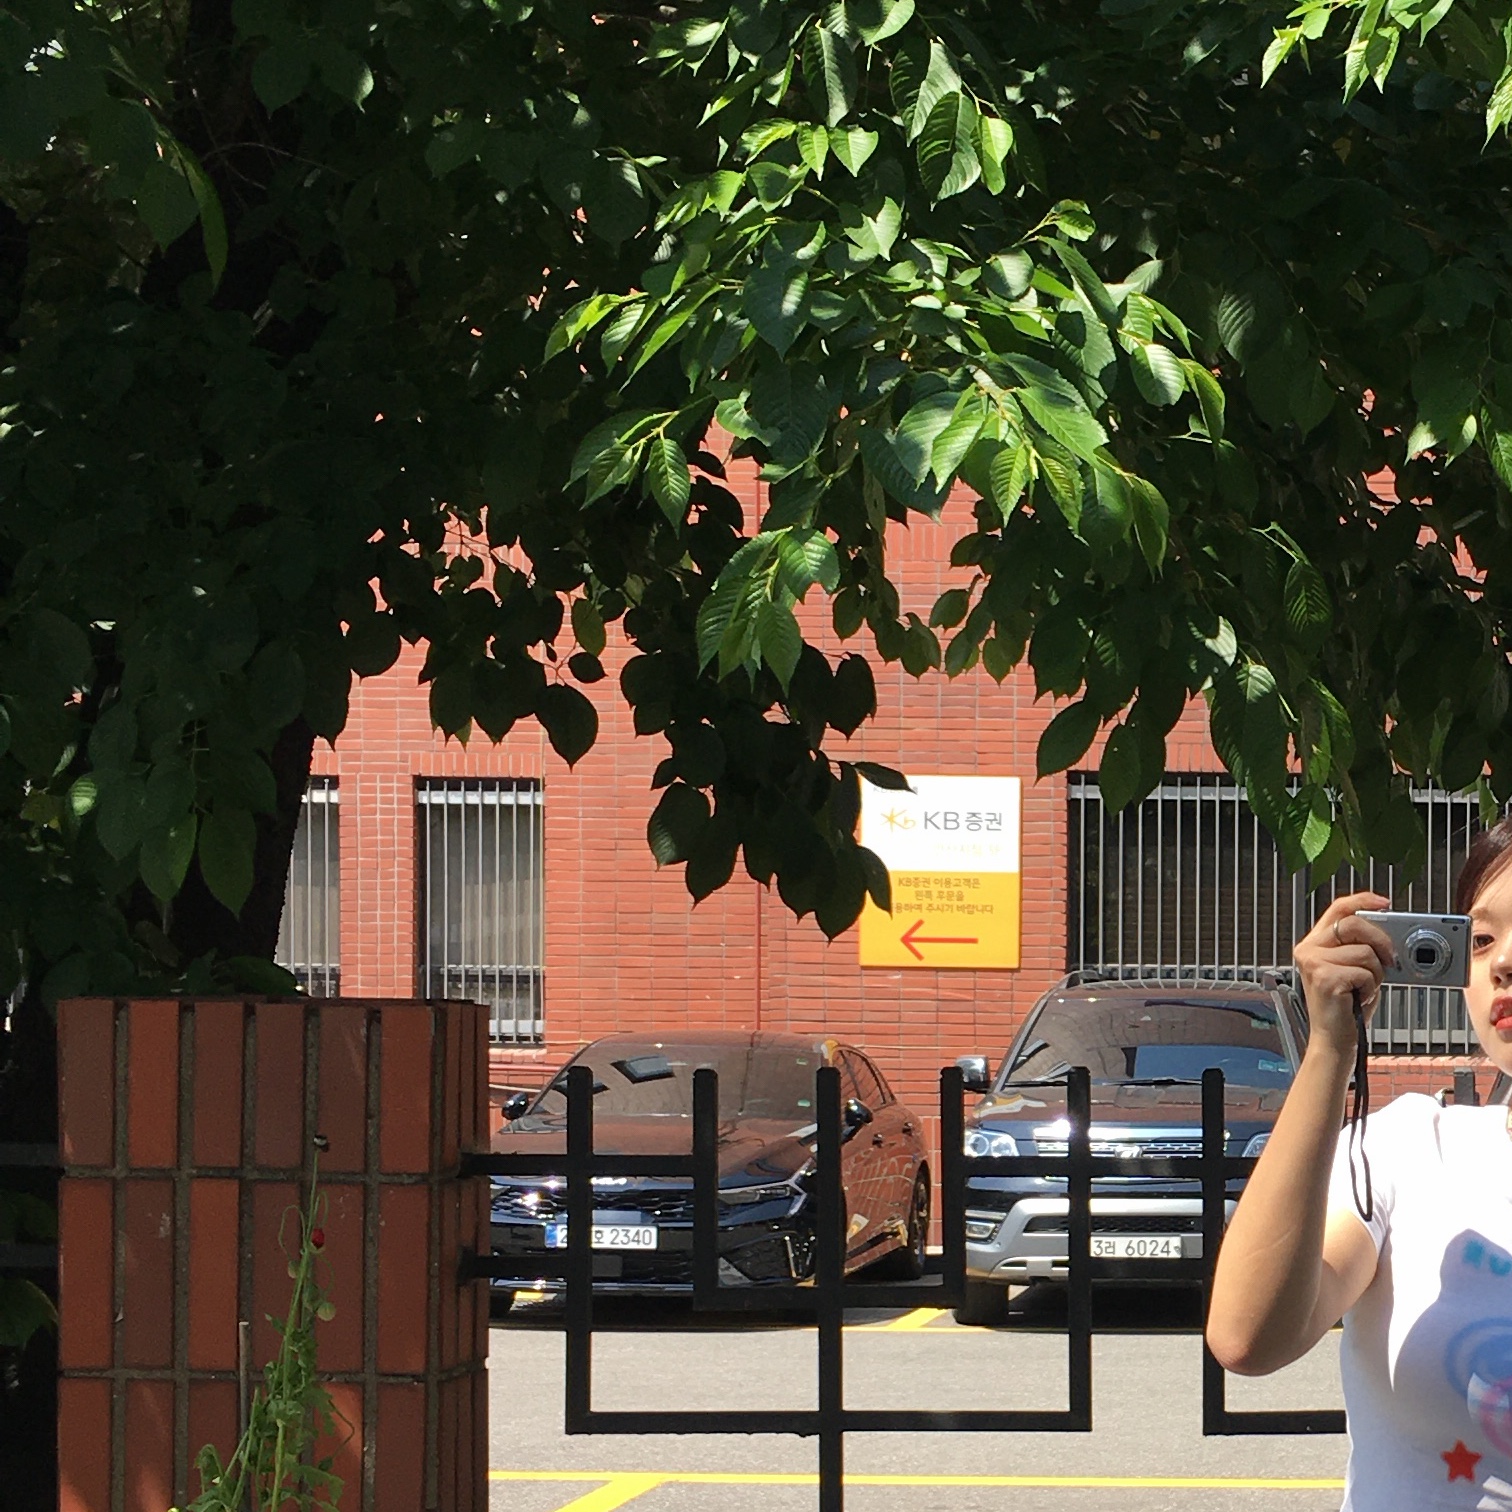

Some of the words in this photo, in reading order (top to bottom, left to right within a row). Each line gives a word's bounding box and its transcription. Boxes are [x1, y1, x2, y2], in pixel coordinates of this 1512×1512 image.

[891, 903, 923, 913] 용하여
[610, 1228, 653, 1246] 2340
[1093, 1240, 1116, 1256] 3러
[1125, 1239, 1171, 1256] 6024
